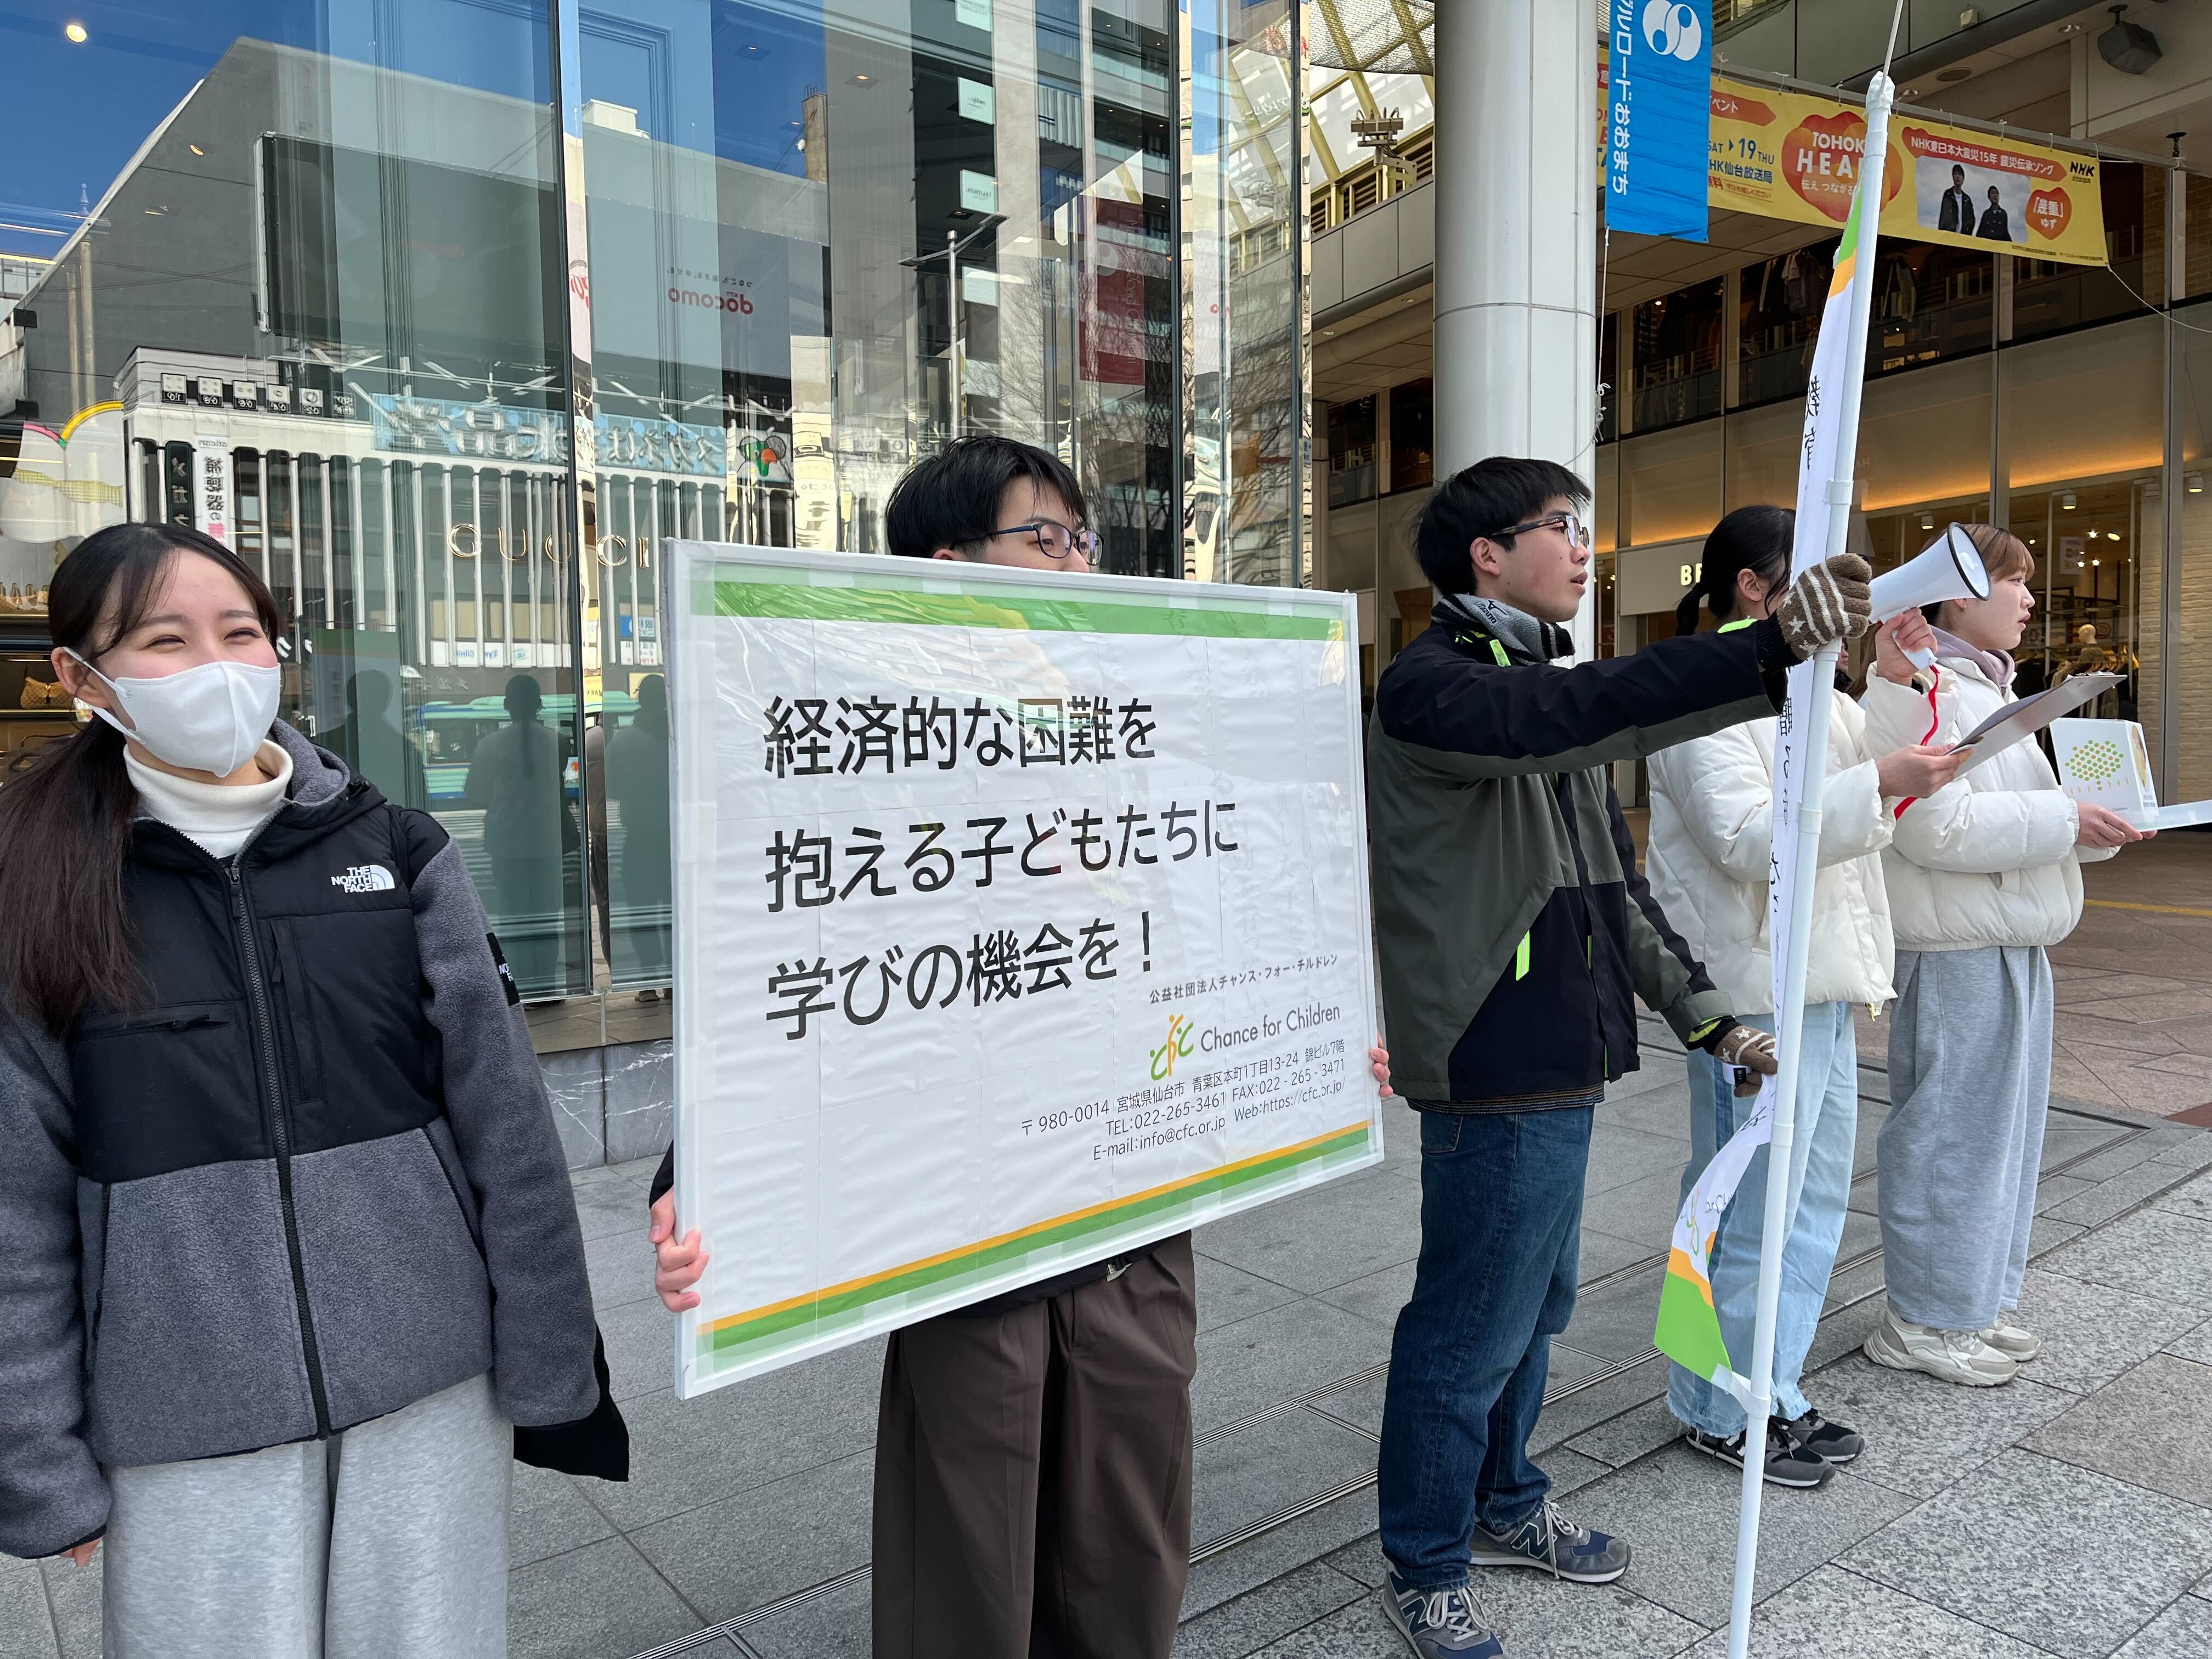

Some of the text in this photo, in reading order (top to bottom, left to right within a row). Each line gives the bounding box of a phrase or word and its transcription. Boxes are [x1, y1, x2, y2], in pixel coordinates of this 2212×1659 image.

[1710, 95, 1739, 114] ベント
[1738, 138, 1757, 160] 19
[1757, 151, 1775, 165] THU
[1812, 131, 1866, 153] TOHOK
[1797, 148, 1865, 178] HEA
[1911, 137, 2054, 176] NHK東日本大震災15年 震災伝承ソング
[2070, 161, 2095, 177] NHK
[1709, 159, 1773, 184] HK仙台放送局
[1801, 180, 1819, 191] 伝え
[2033, 196, 2064, 218] 「幾重」
[2040, 218, 2057, 230] ゆず
[446, 523, 650, 568] GUCCI
[763, 695, 1156, 778] 経済的な困難を
[765, 799, 1239, 912] 抱える子どもたちに
[330, 873, 372, 885] NORTH
[346, 866, 370, 876] THE
[343, 882, 373, 893] FACE
[1150, 954, 1338, 1004] 公益社団法人チャンス・フォー・チルドレン
[1201, 1002, 1340, 1052] Chance for Children
[1039, 1099, 1110, 1132] 980-0014
[1117, 1081, 1186, 1113] 宮城県仙台市
[1192, 1052, 1299, 1093] 青葉区本町1丁目13-24
[1305, 1039, 1345, 1063] 錦ビル7階
[1093, 1076, 1346, 1161] E-mail:info@cfc.or.jp Web:https://cfc.or.jp/
[1105, 1091, 1225, 1136] TEL:022-265-3461
